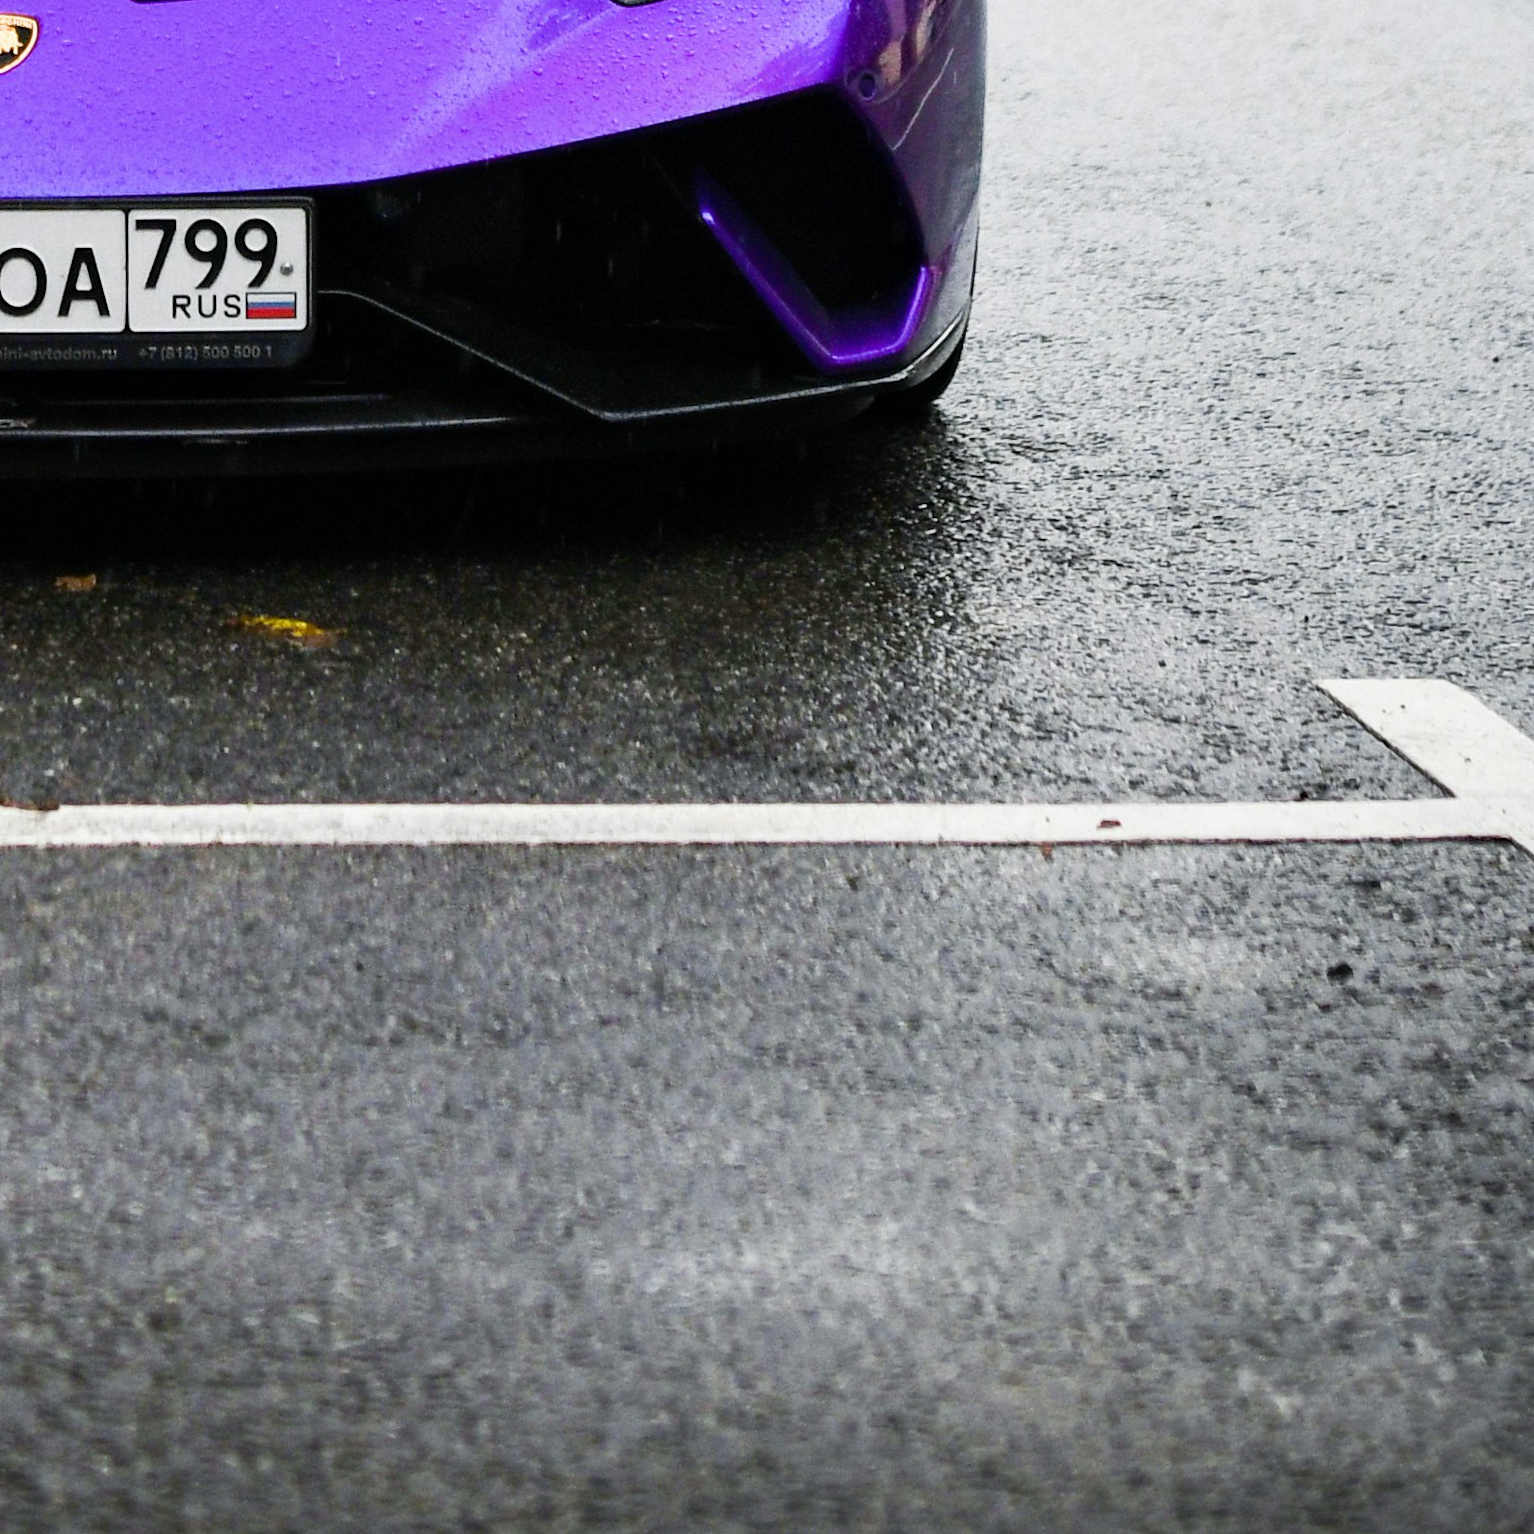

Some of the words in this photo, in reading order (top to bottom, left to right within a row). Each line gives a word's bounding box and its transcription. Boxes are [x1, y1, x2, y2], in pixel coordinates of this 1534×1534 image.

[134, 218, 279, 289] 799
[171, 294, 242, 319] RUS
[138, 345, 157, 359] +7
[160, 344, 199, 362] (812)
[202, 344, 230, 359] 500
[234, 344, 261, 359] 500
